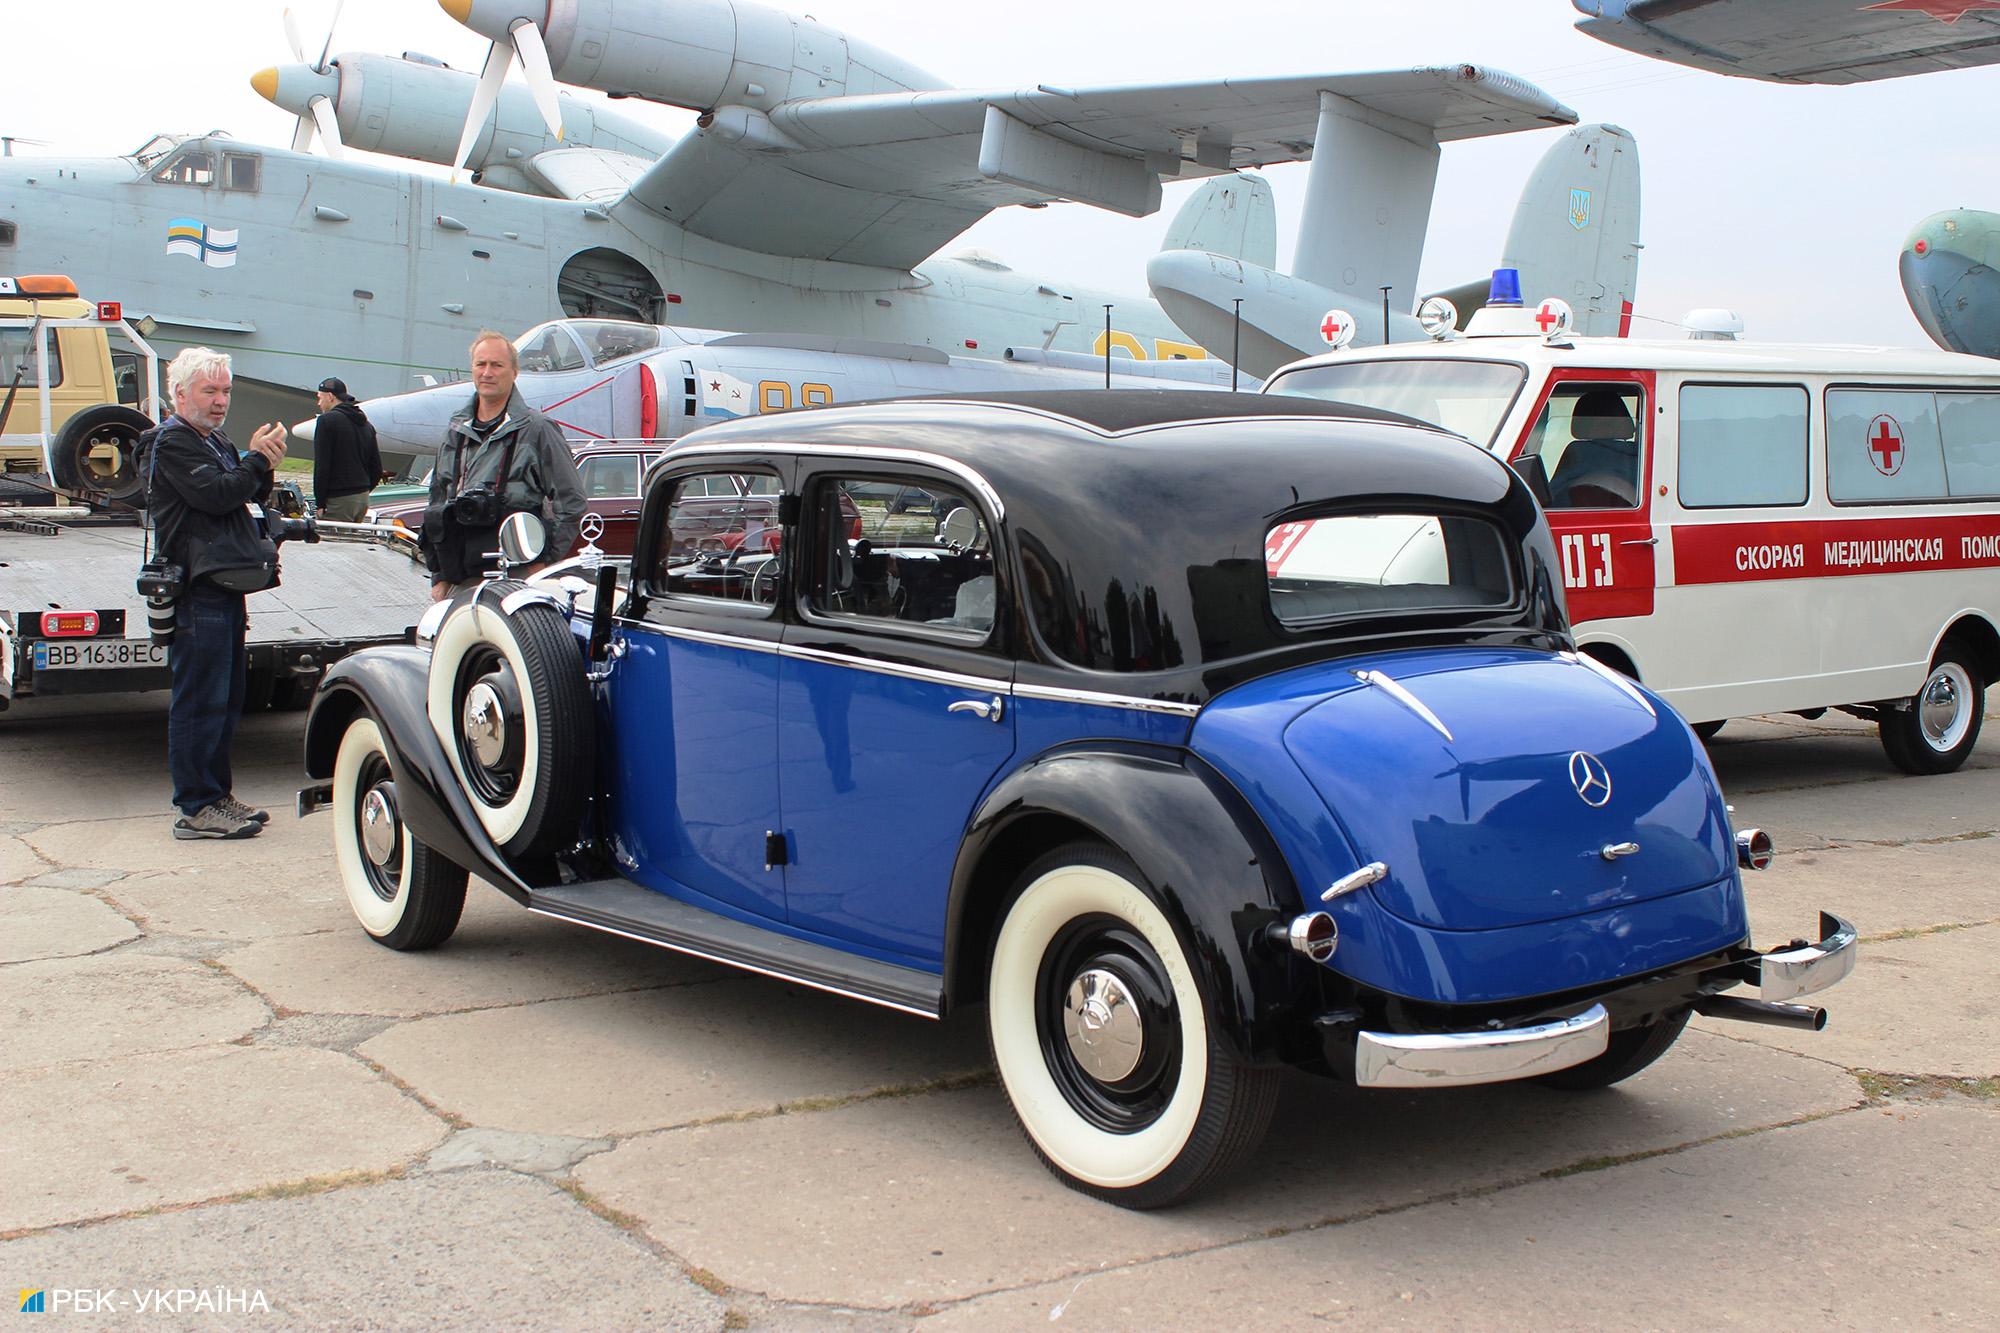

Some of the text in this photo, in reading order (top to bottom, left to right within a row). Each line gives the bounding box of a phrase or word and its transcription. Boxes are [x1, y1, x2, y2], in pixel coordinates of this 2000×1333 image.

[1561, 533, 1613, 588] 03
[1735, 543, 1804, 571] СКОРАЯ
[1824, 537, 1943, 568] МЕДИЦИНСКАЯ
[49, 646, 79, 665] BB
[134, 644, 163, 663] EC
